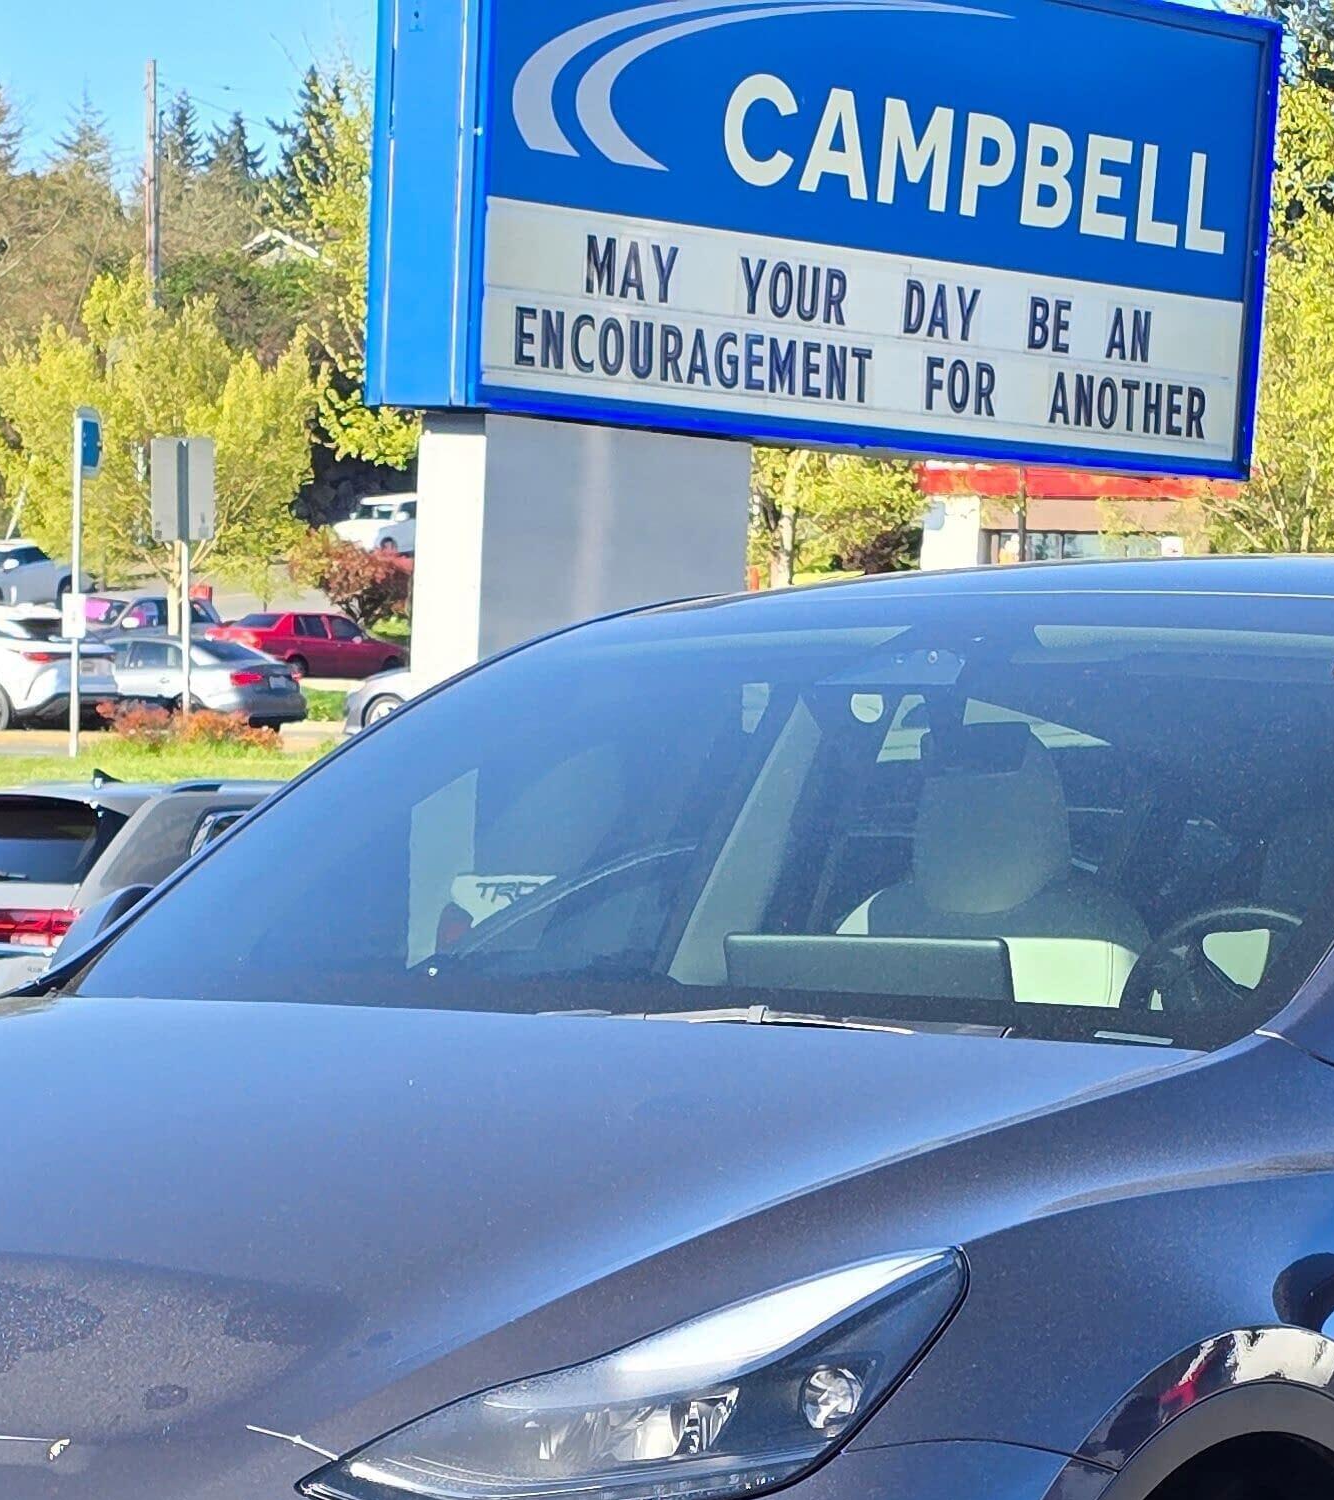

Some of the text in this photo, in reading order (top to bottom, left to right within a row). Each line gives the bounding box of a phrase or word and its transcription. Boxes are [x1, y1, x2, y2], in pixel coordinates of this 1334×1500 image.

[724, 73, 1226, 255] CAMPBELL
[585, 234, 1152, 363] MAY YOUR DAY BE AN
[514, 305, 1206, 440] ENCOURAGEMENT FOR ANOTHER
